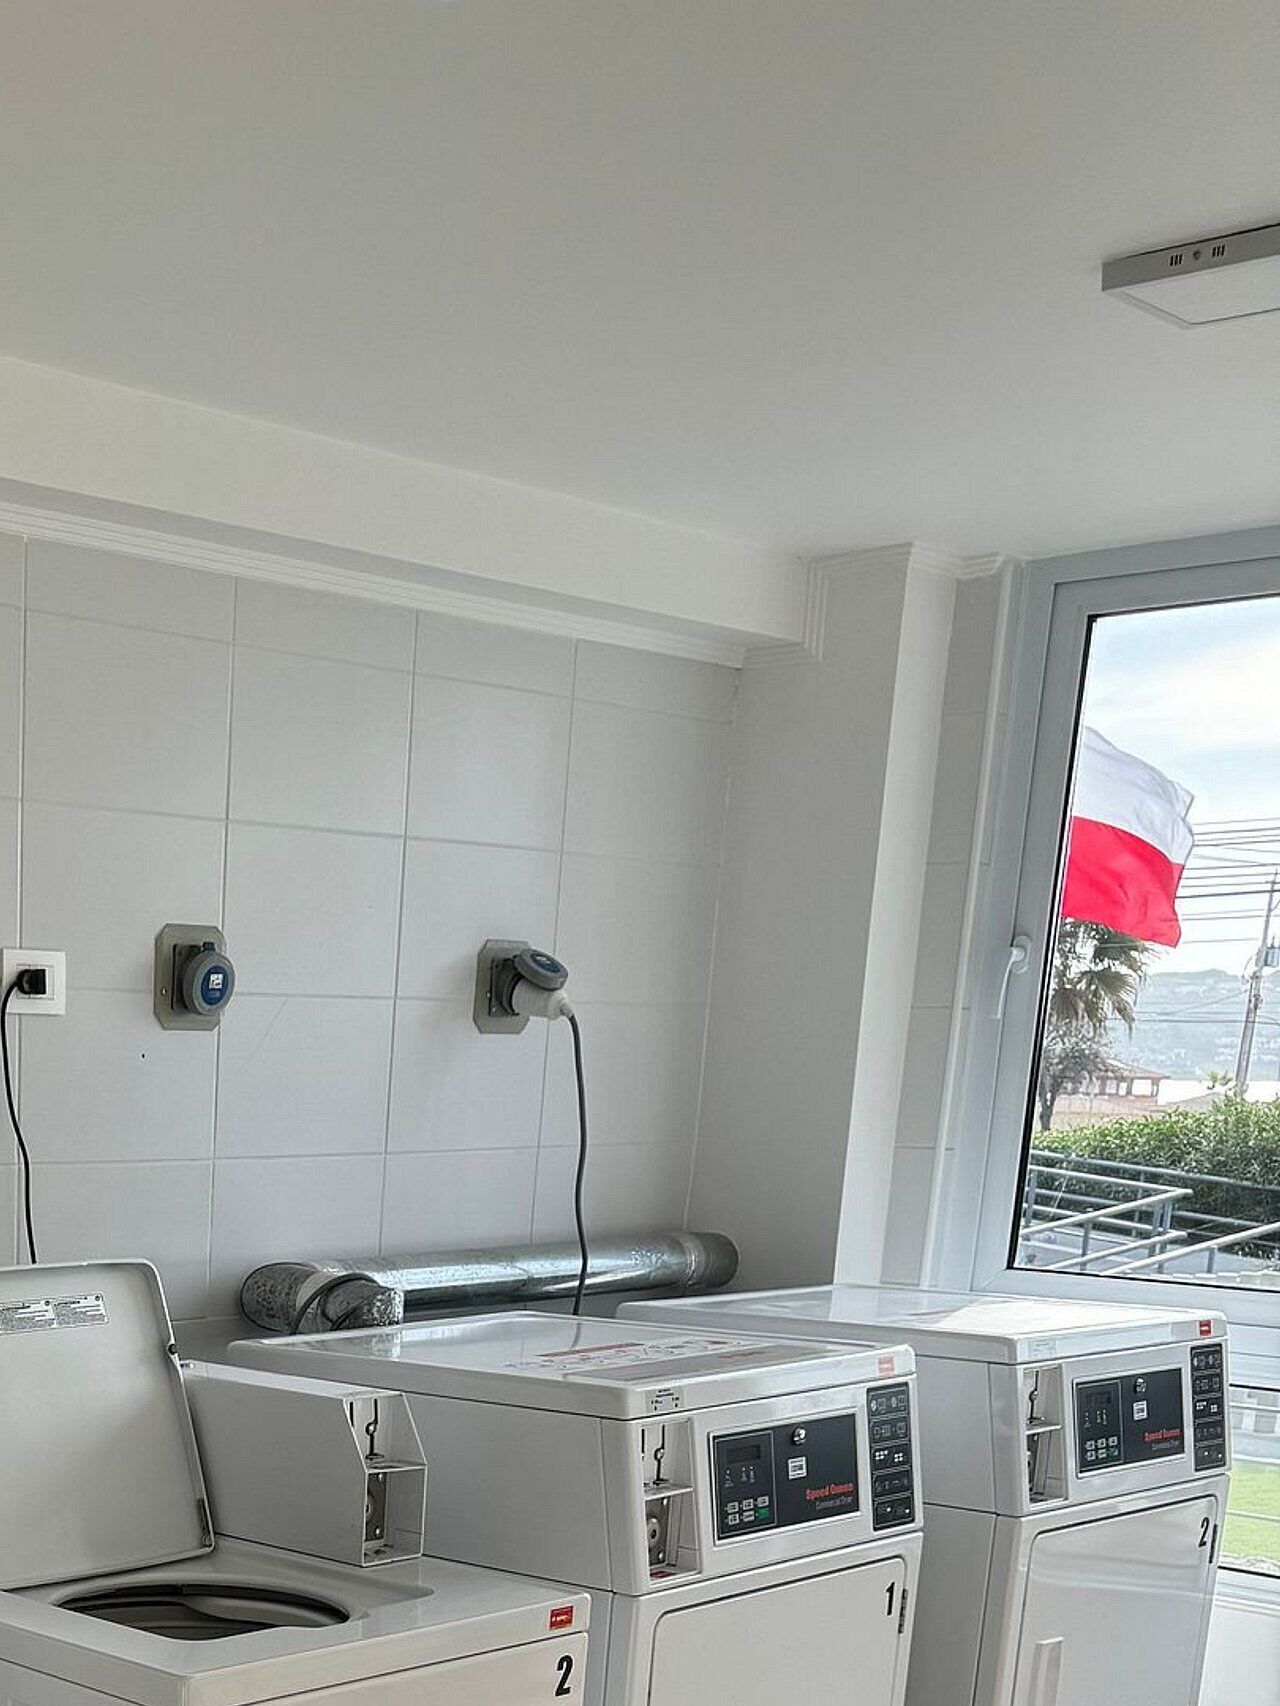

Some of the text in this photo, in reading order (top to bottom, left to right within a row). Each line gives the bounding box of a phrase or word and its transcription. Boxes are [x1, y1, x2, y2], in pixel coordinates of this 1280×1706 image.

[1198, 1516, 1209, 1548] 2
[884, 1582, 895, 1616] 1
[554, 1654, 573, 1697] 2
